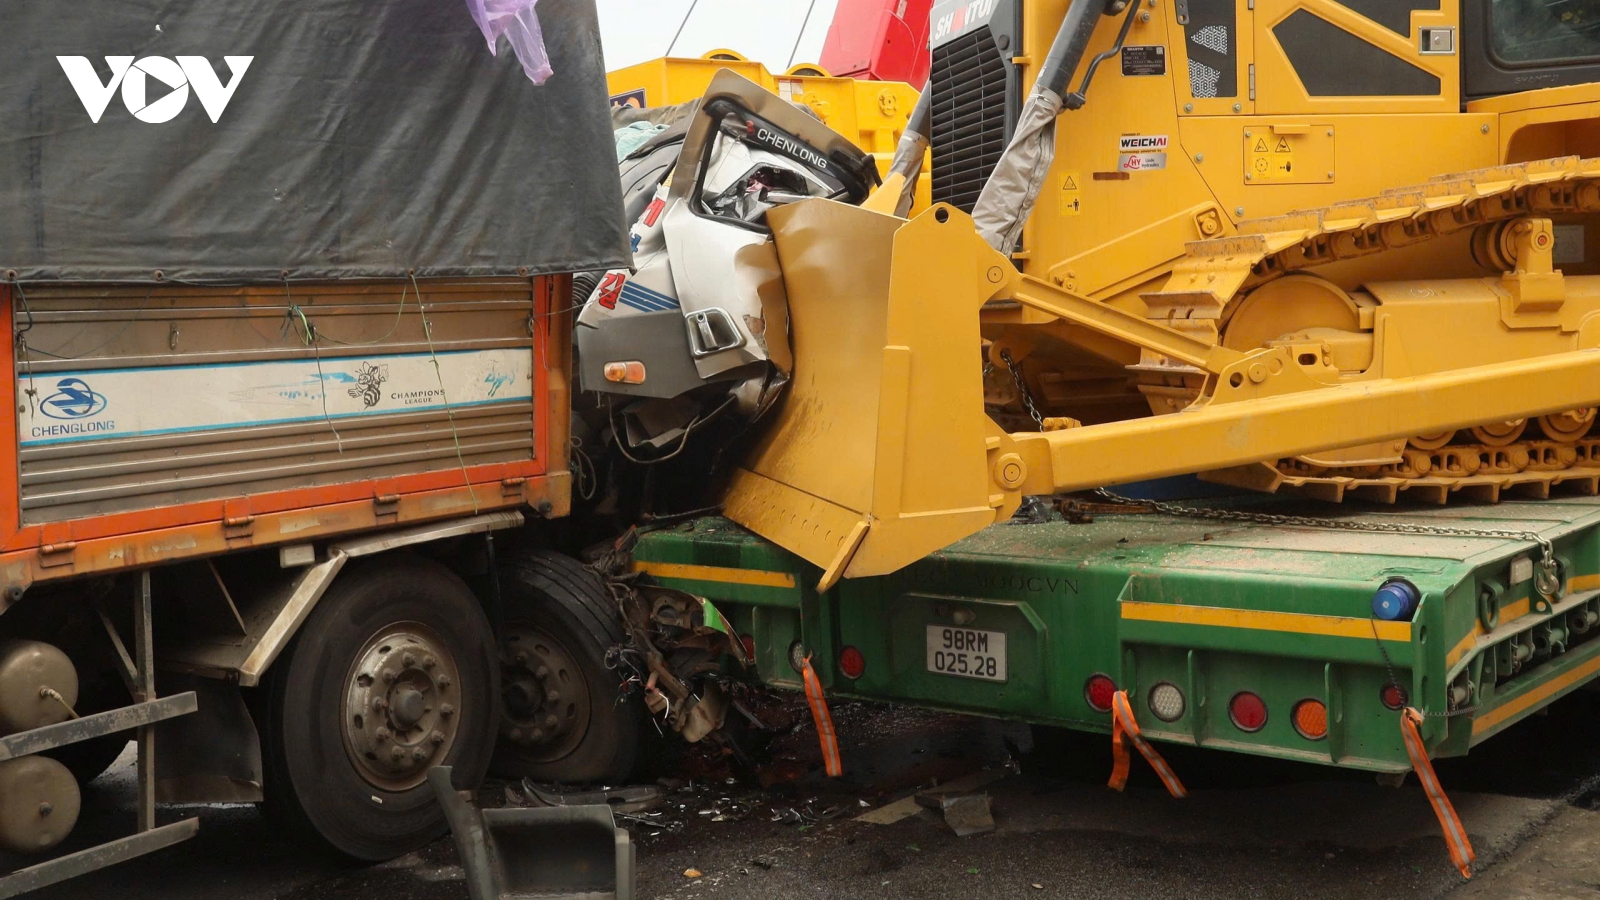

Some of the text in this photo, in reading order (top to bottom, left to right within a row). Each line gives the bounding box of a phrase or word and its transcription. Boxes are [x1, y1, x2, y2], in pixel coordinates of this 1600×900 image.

[757, 128, 828, 169] CHENLONG
[1121, 138, 1166, 147] WEICHAI
[391, 389, 446, 400] CHAMPIONS
[404, 397, 433, 405] LEAGUE
[31, 420, 115, 437] CHENGLONG
[942, 628, 988, 653] 98RM
[935, 651, 997, 677] 025.28
